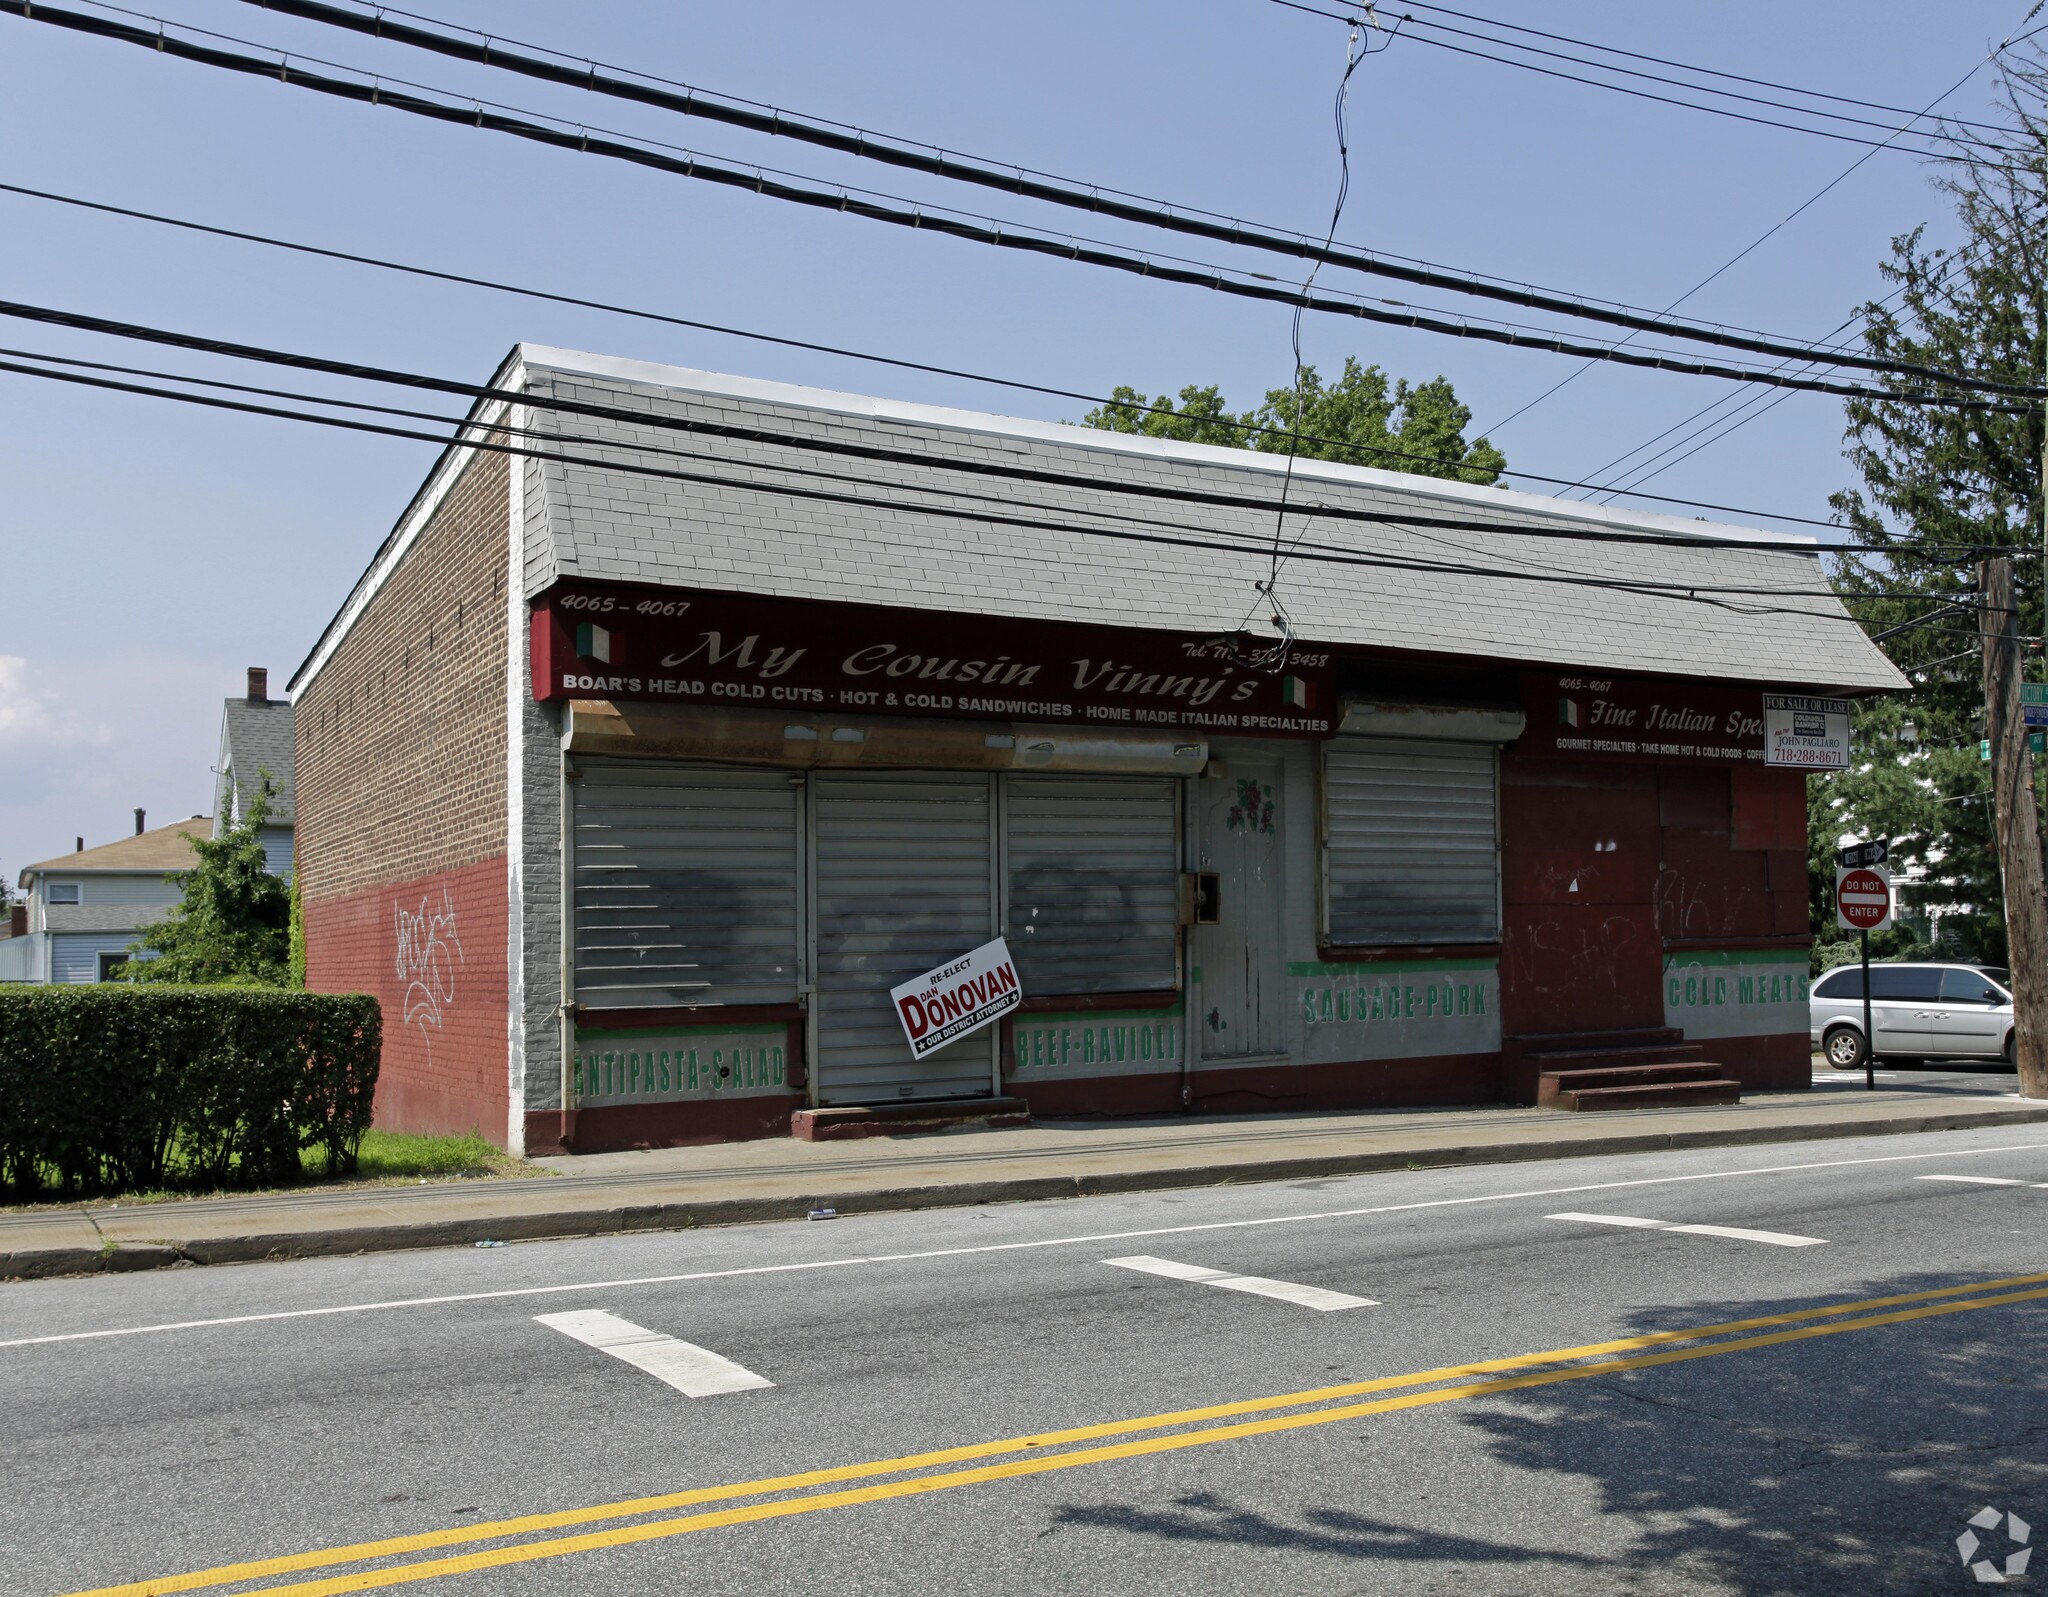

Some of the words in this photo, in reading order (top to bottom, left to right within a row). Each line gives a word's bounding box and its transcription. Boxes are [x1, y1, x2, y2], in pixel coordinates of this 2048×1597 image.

[661, 631, 807, 678] My
[842, 644, 1042, 686] Cousin
[1072, 659, 1260, 706] Vinny's
[563, 674, 642, 692] BOAR'S
[648, 678, 705, 695] HEAD
[711, 681, 766, 698] COLD
[771, 685, 824, 702] CUTS
[840, 690, 879, 705] HOT
[885, 692, 898, 706] &
[904, 693, 953, 709] COLD
[958, 697, 1073, 716] SANDWICHES
[1086, 705, 1131, 721] HOME
[1135, 709, 1177, 724] MADE
[1181, 712, 1238, 727] ITALIAN
[1241, 715, 1329, 732] SPECIALTIES
[1766, 696, 1786, 709] FOR
[1787, 697, 1809, 710] SALE
[1810, 699, 1822, 711] OR
[1823, 701, 1847, 713] LEASE
[1590, 699, 1637, 727] Fine
[1645, 704, 1717, 732] Italian
[1557, 738, 1592, 750] GOURMET
[1593, 740, 1637, 753] SPECIALTIES
[1641, 743, 1659, 754] TAKE
[1660, 744, 1680, 755] HOME
[1681, 746, 1694, 756] HOT
[1695, 747, 1701, 757] &
[1702, 747, 1720, 758] COLD
[1721, 748, 1742, 759] FOODS
[1778, 736, 1801, 748] JOHN
[1802, 737, 1840, 748] PAGLIARO
[2033, 735, 2043, 744] AV
[1866, 847, 1880, 858] WAY
[1846, 881, 1859, 890] DO
[1862, 881, 1880, 891] NOT
[1849, 907, 1878, 917] ENTER
[929, 958, 972, 985] RE-ELECT
[898, 961, 1017, 1040] DONOVAN
[920, 986, 939, 1002] DAN
[1668, 976, 1727, 1008] COLD
[1738, 974, 1809, 1004] MEATS
[926, 1034, 943, 1046] OUR
[942, 1015, 975, 1039] DISTRICT
[976, 997, 1010, 1021] ATTORNEY
